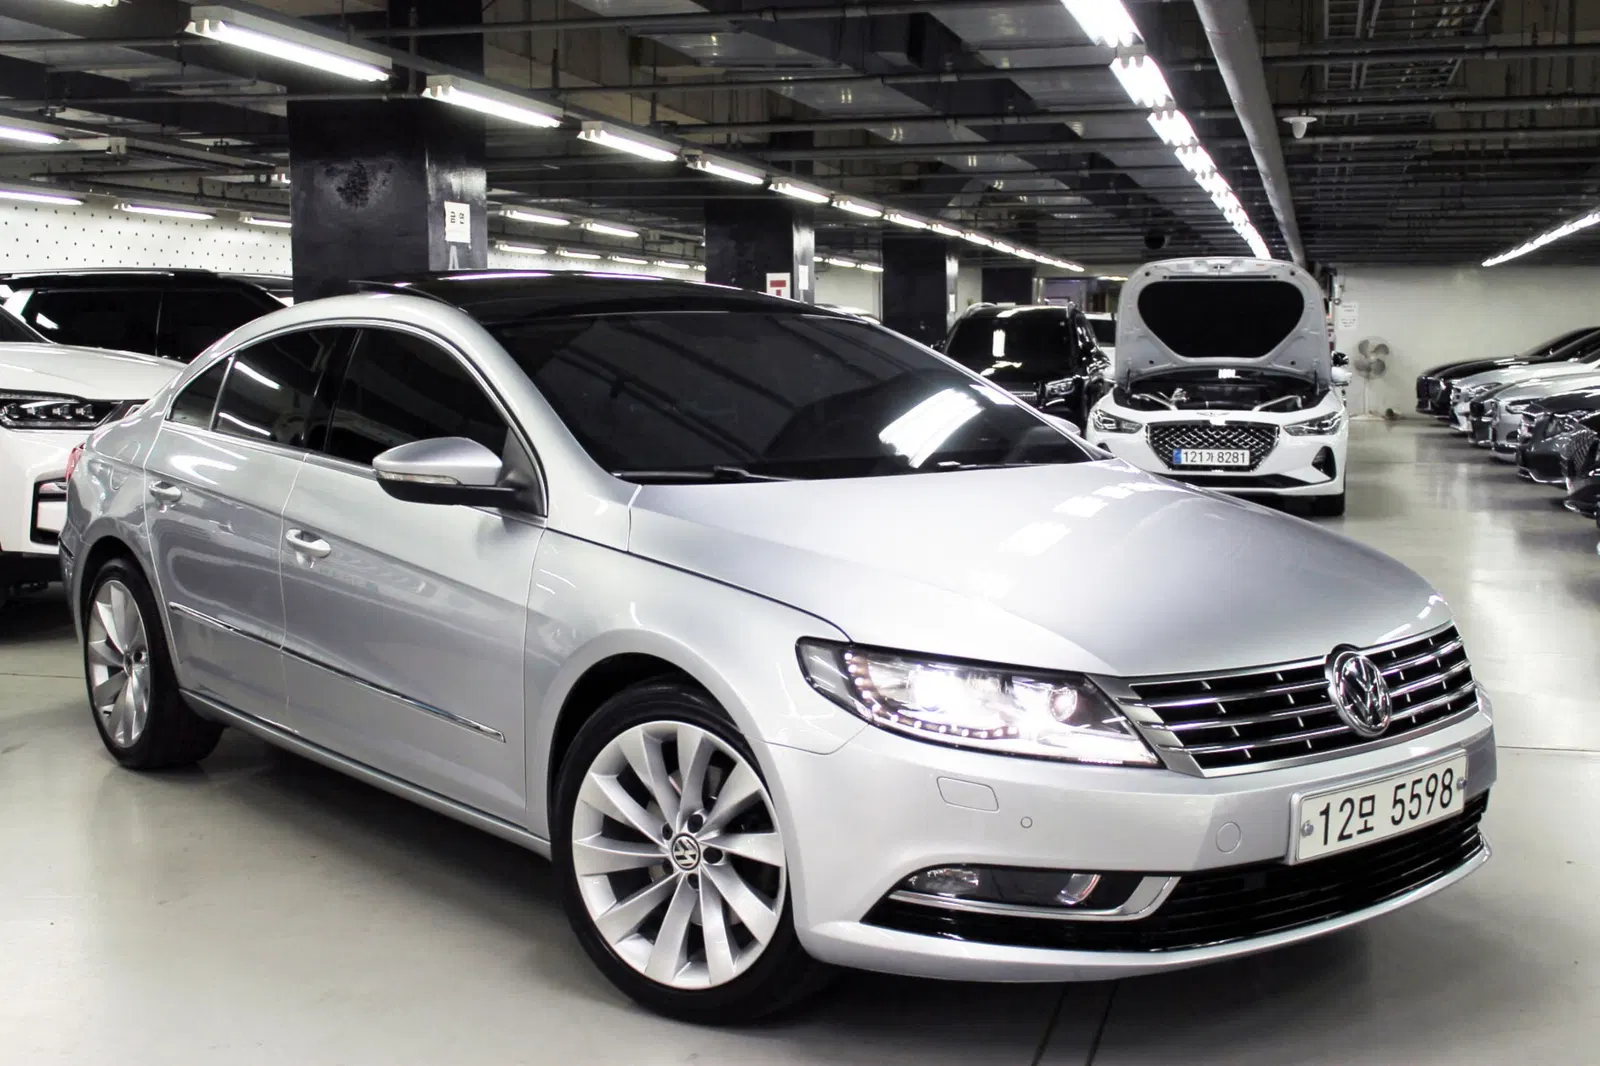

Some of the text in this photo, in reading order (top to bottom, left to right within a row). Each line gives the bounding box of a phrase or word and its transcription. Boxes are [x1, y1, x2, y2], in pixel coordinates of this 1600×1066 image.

[1217, 451, 1245, 464] 8281
[1319, 767, 1454, 846] 12모 5598
